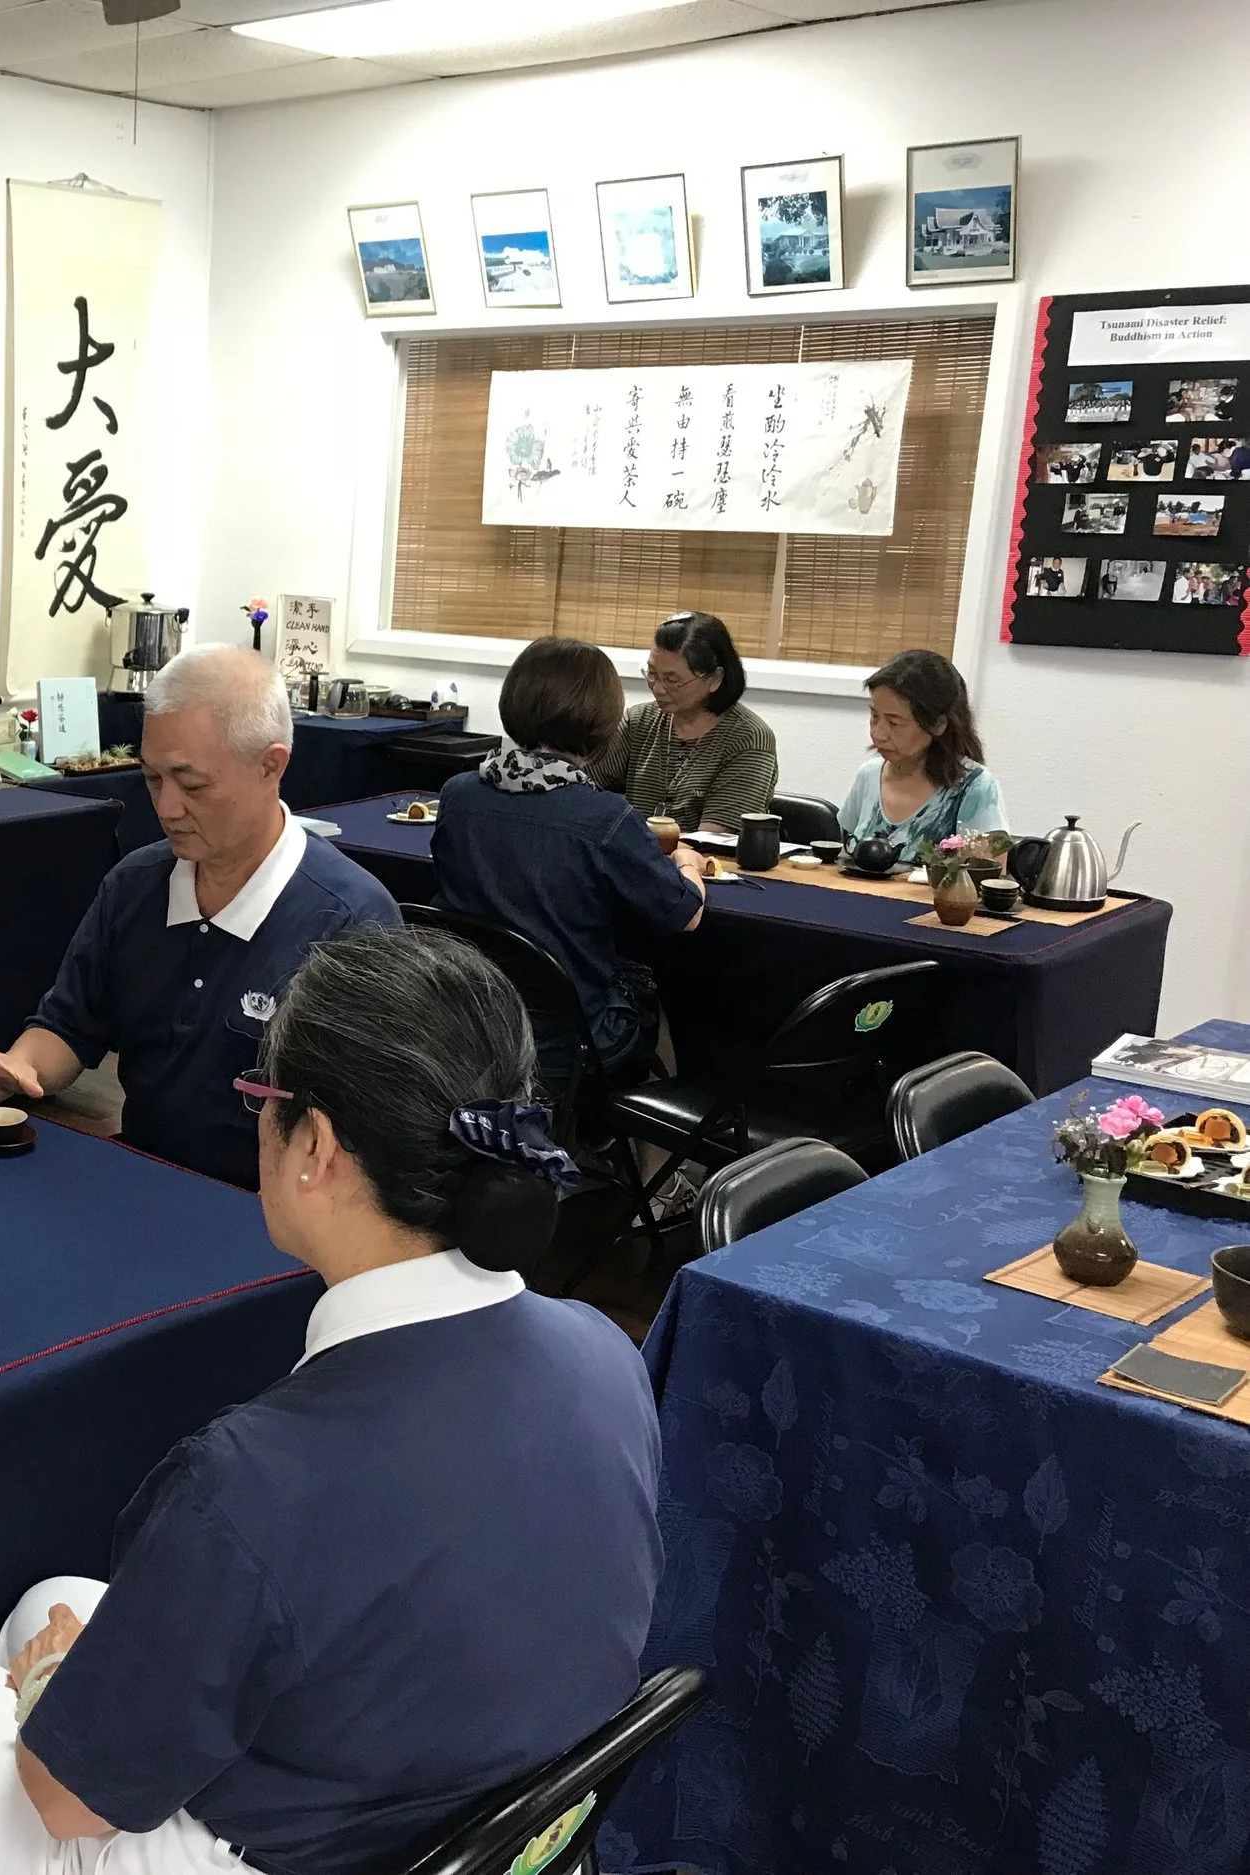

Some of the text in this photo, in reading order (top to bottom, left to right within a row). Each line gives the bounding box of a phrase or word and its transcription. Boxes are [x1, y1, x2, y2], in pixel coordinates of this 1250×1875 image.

[1100, 315, 1227, 330] Tsunami Disaster Relief:
[1110, 330, 1213, 342] Buddhism in Action
[35, 296, 128, 617] 大愛
[286, 620, 330, 633] CLEAN HAND
